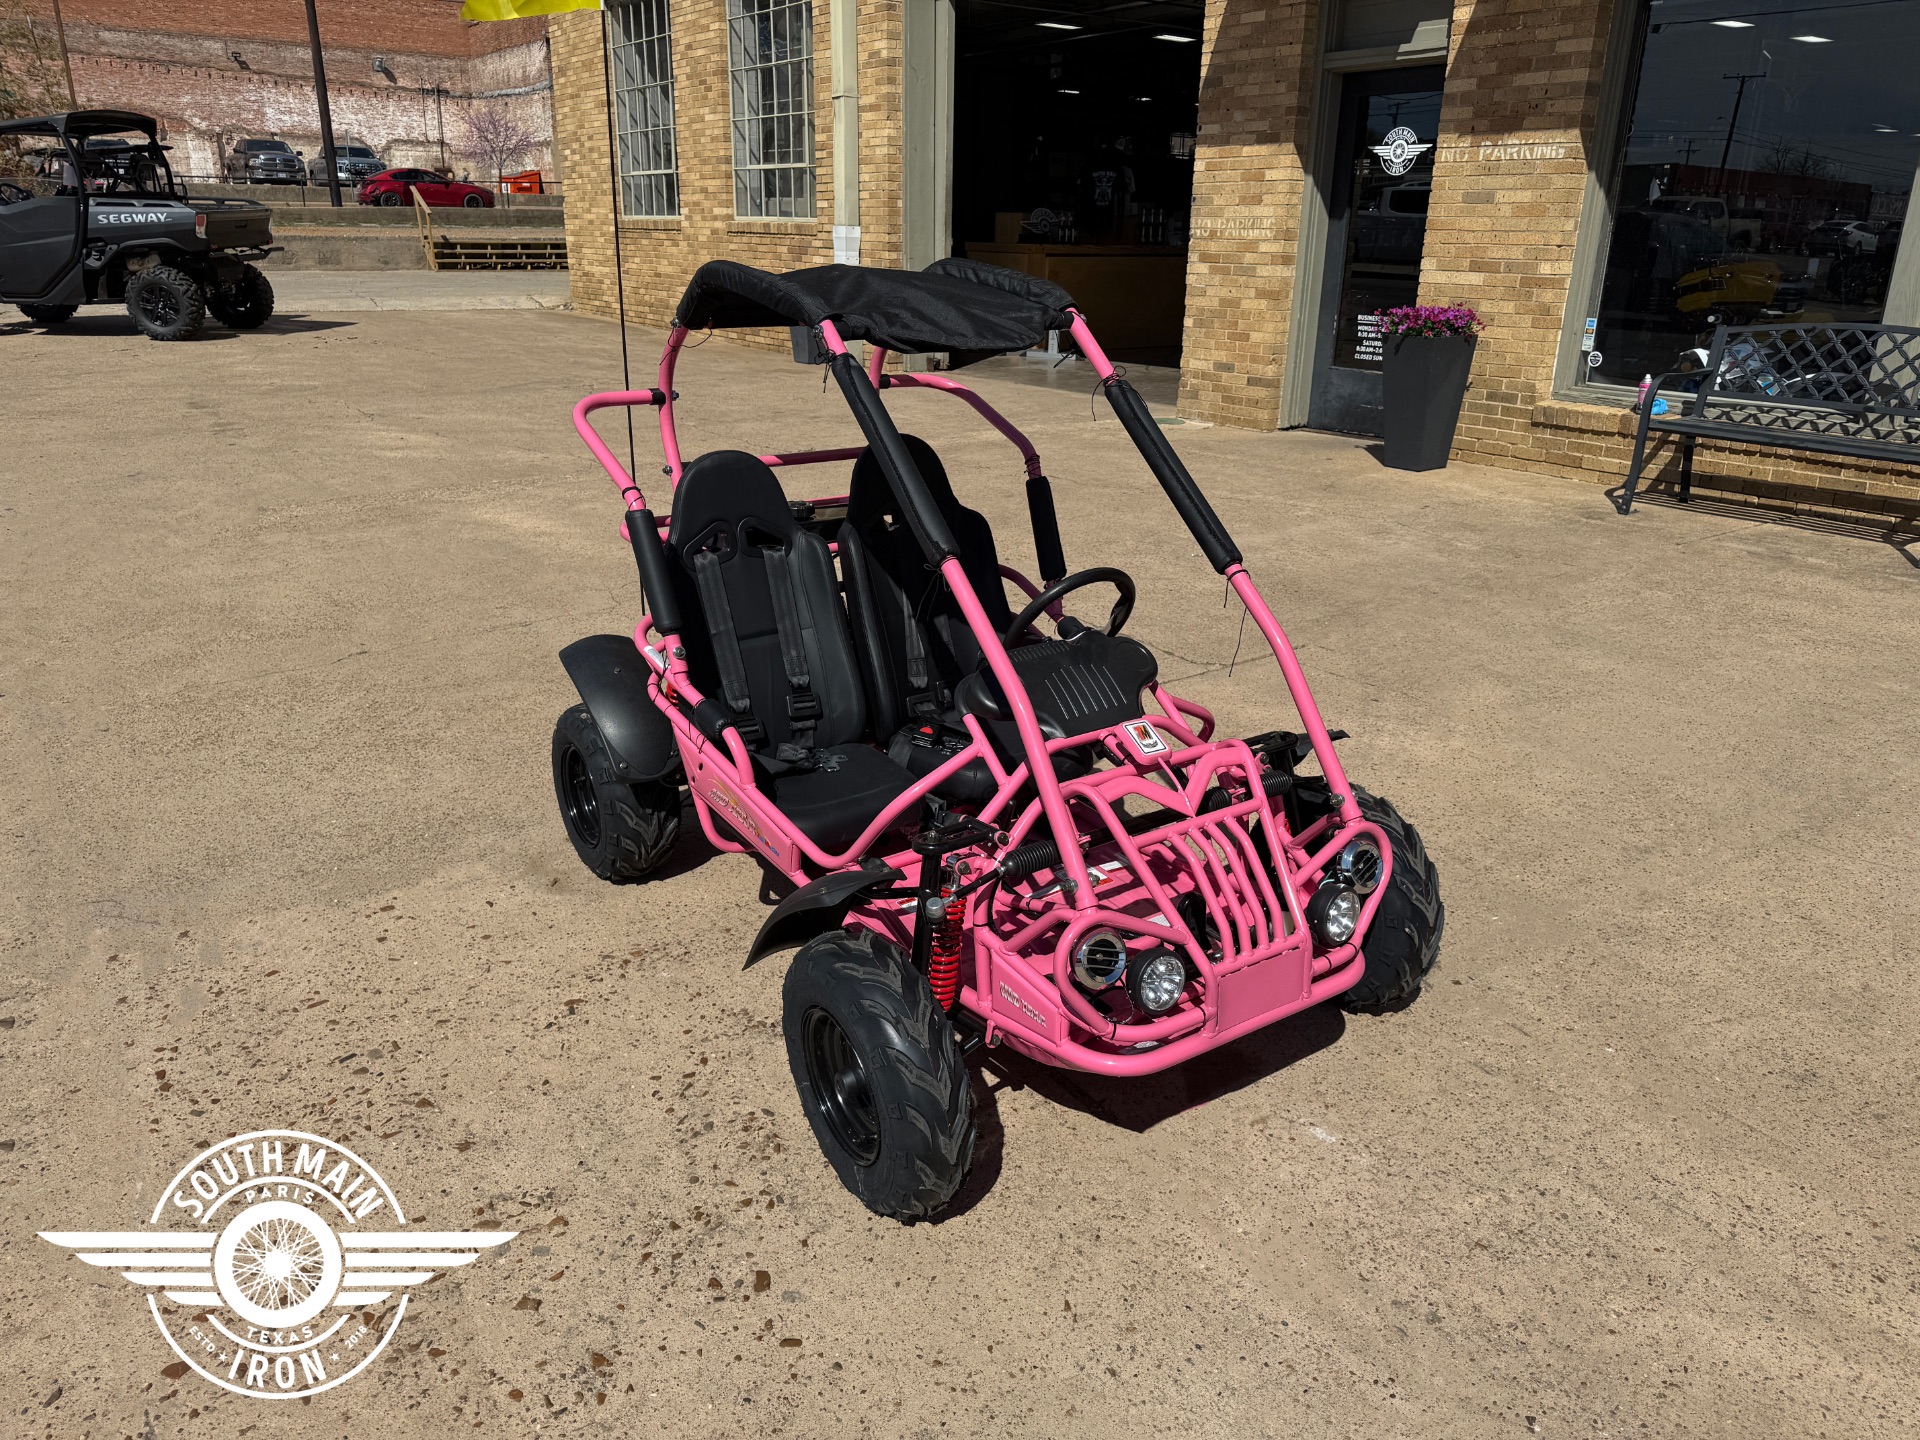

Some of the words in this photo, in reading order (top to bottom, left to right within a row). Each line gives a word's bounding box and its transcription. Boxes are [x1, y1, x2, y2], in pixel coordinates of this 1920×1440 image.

[1385, 128, 1403, 144] SOUTH
[1403, 128, 1416, 144] MAIN
[1441, 142, 1468, 162] NO
[1480, 138, 1565, 161] PARKING
[1389, 166, 1404, 174] IRON
[97, 213, 168, 224] SEGWAY
[1191, 218, 1210, 237] NO
[1217, 218, 1276, 237] PARKING
